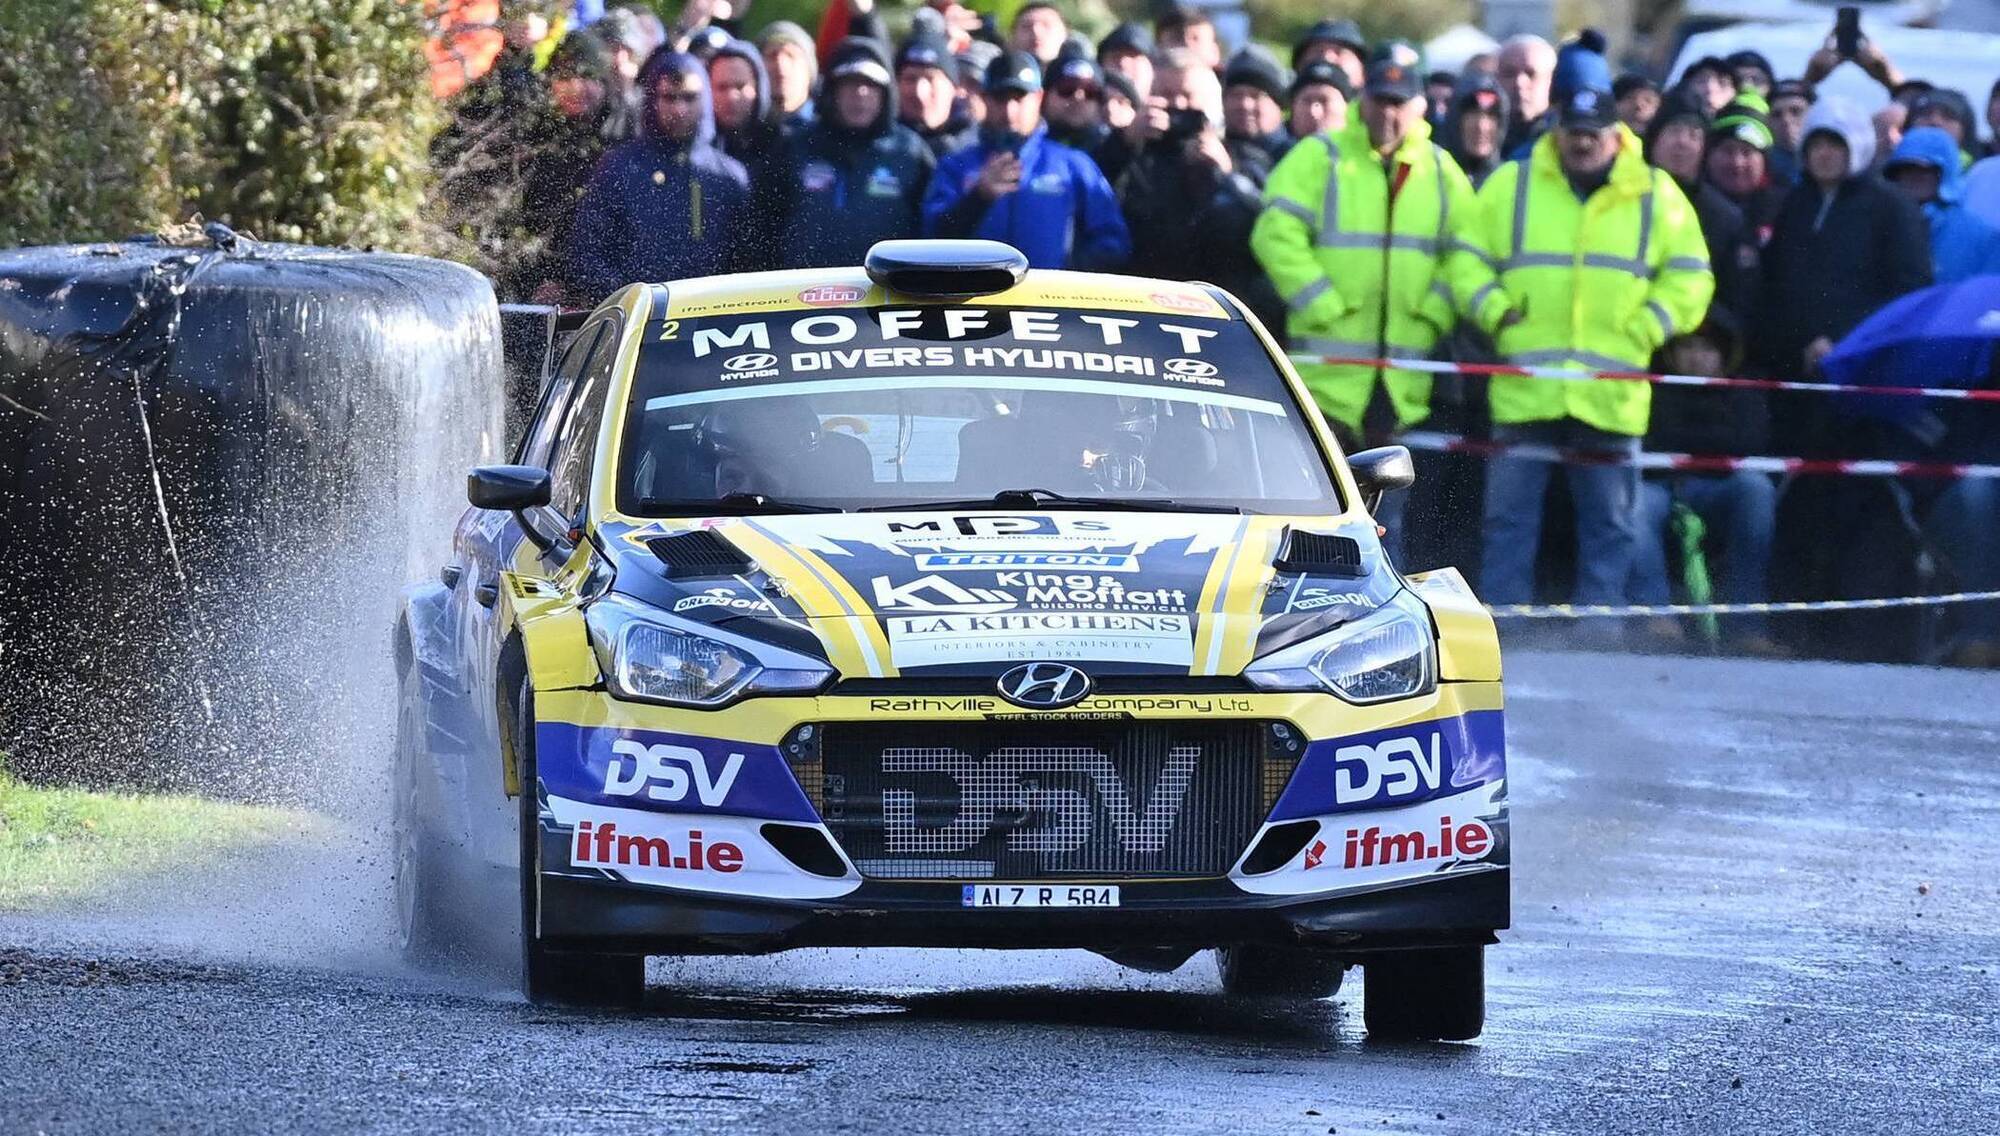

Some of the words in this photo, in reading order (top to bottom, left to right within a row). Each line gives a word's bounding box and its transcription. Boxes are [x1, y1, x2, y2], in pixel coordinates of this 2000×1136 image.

[712, 298, 791, 309] electronic
[660, 320, 680, 340] 2
[691, 310, 1219, 358] MOFFETT
[791, 346, 955, 372] DIVERS
[964, 346, 1156, 377] HYUNDAI
[940, 554, 1110, 566] TRITON
[1025, 586, 1187, 606] Moffatt
[1030, 602, 1106, 611] BUILDING
[1112, 603, 1188, 613] SERVICES
[903, 617, 957, 634] LA
[967, 614, 1182, 633] KITCHENS
[933, 640, 1028, 651] INTERIORS
[1055, 640, 1154, 649] CABINETRY
[1007, 650, 1036, 659] EST
[870, 698, 996, 712] Rathville
[1218, 697, 1255, 712] Ltd.
[1030, 712, 1068, 721] STOCK
[1070, 712, 1122, 720] HOLDERS
[603, 738, 746, 807] DSV
[1334, 732, 1441, 805] DSV
[881, 747, 1201, 852] DSV
[576, 821, 744, 873] ifm.ie
[1343, 816, 1489, 870] ifm.ie
